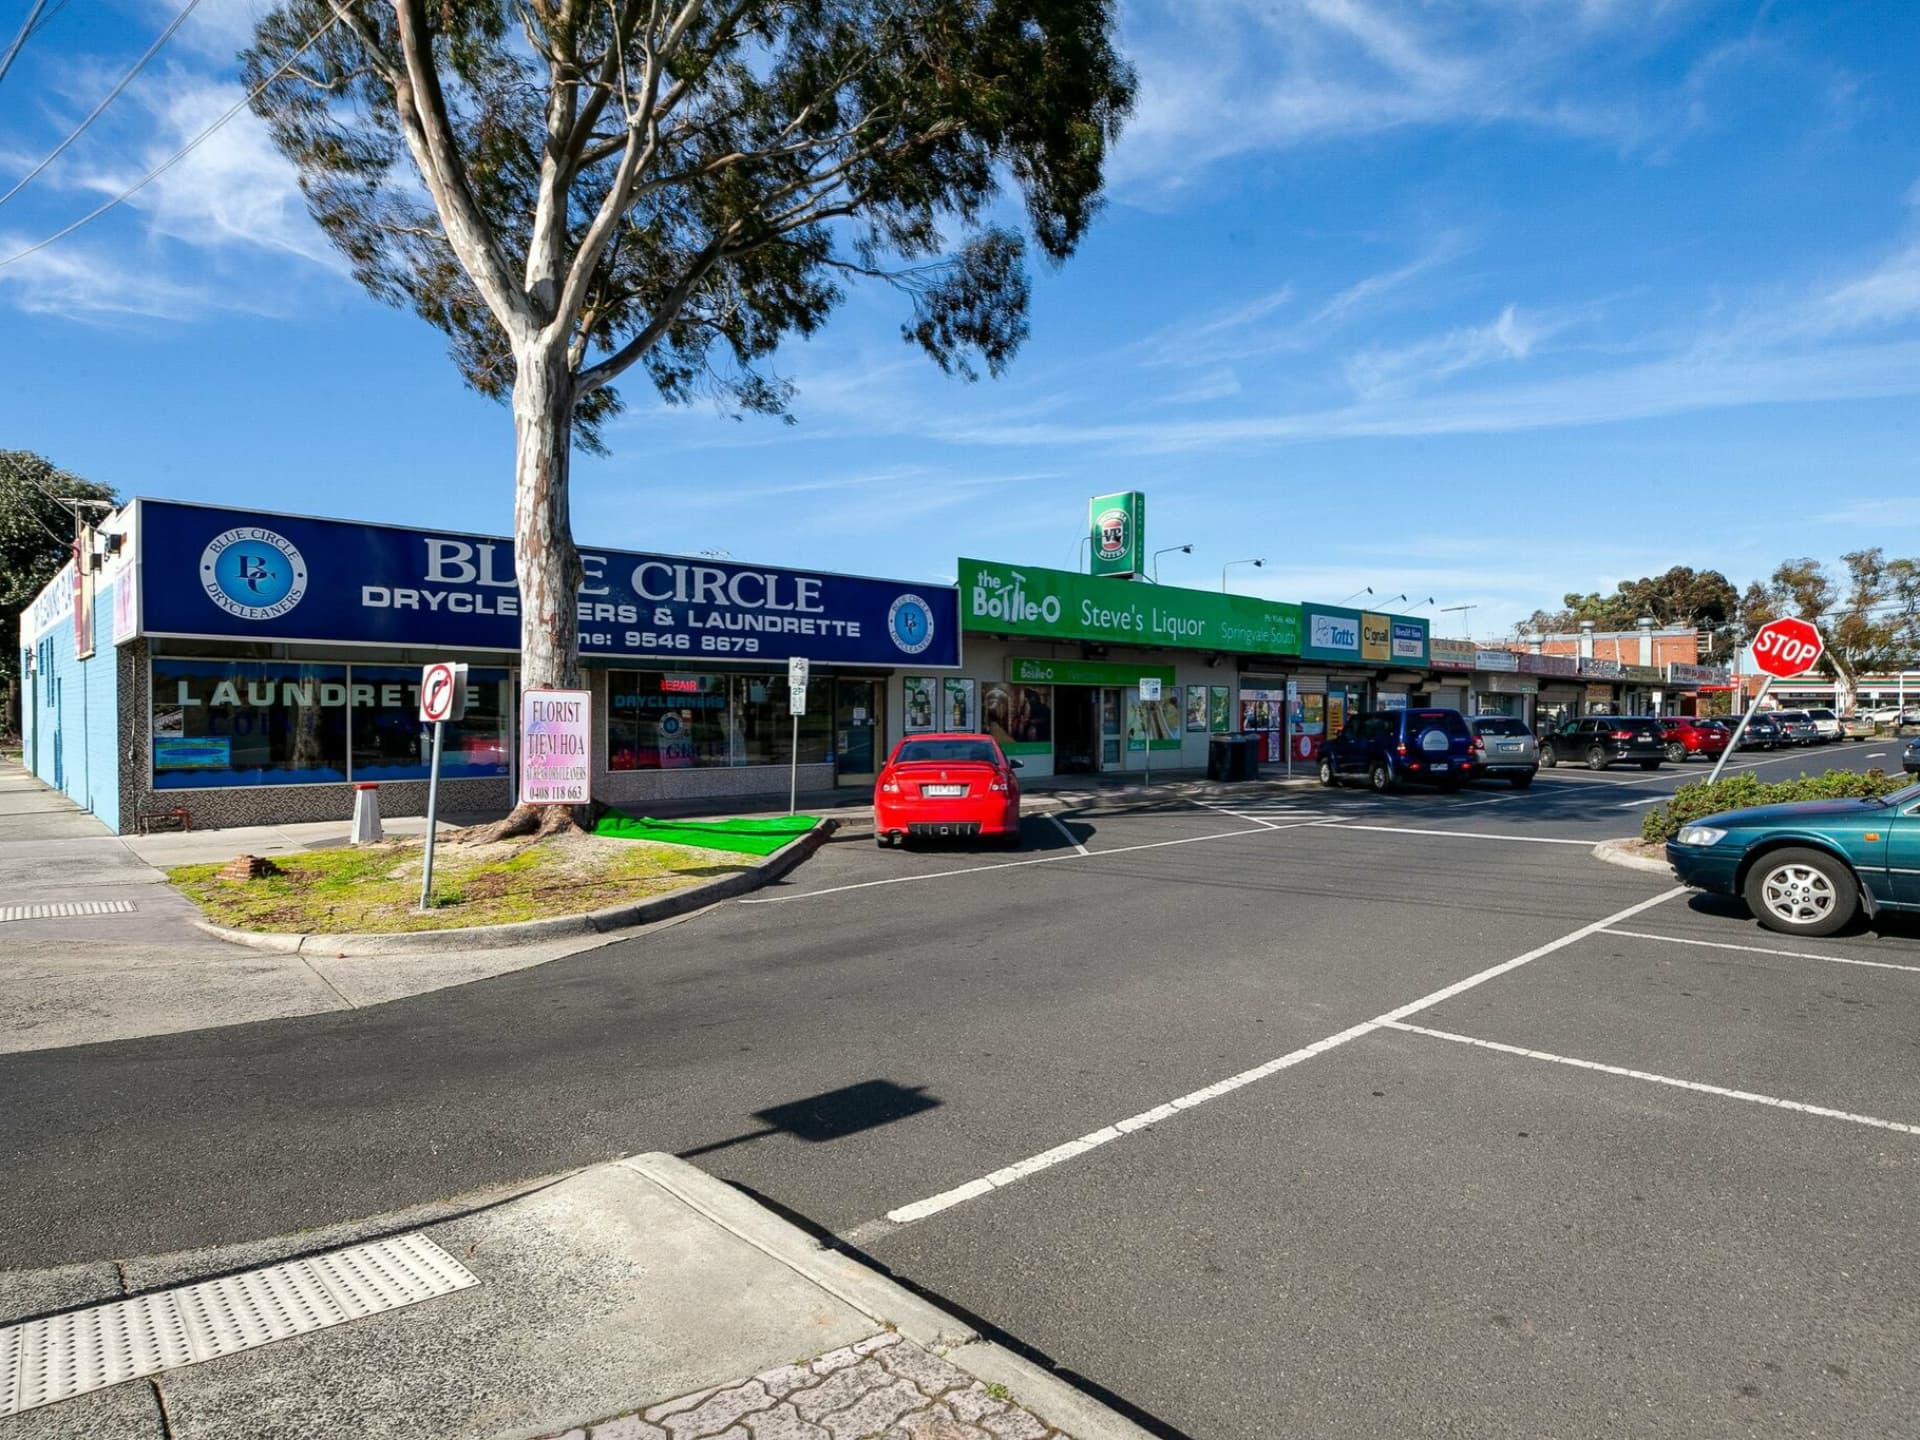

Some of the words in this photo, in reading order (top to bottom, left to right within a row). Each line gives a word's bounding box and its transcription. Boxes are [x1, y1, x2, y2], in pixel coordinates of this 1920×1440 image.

[209, 529, 246, 554] BLUE
[251, 529, 300, 560] CIRCLE
[424, 538, 610, 595] BLE
[631, 561, 824, 612] CIRCLE
[977, 569, 1000, 588] the
[206, 582, 302, 618] DRYCLEANERS
[362, 585, 638, 624] DRYCLEERS
[653, 605, 675, 626] &
[688, 610, 861, 638] LAUNDRETTE
[1081, 599, 1144, 632] Steve's
[1152, 607, 1206, 640] Liquor
[625, 631, 690, 650] 9546
[701, 636, 759, 652] 8679
[1271, 627, 1296, 645] South
[1330, 626, 1355, 646] Tatts
[1756, 630, 1817, 665] STOP
[178, 680, 480, 707] LAUNDRETE
[660, 679, 697, 692] REPAIR
[532, 700, 582, 722] FLORIST
[560, 734, 585, 755] HOA
[529, 786, 550, 800] 0408
[552, 786, 566, 799] 118
[567, 786, 582, 800] 663
